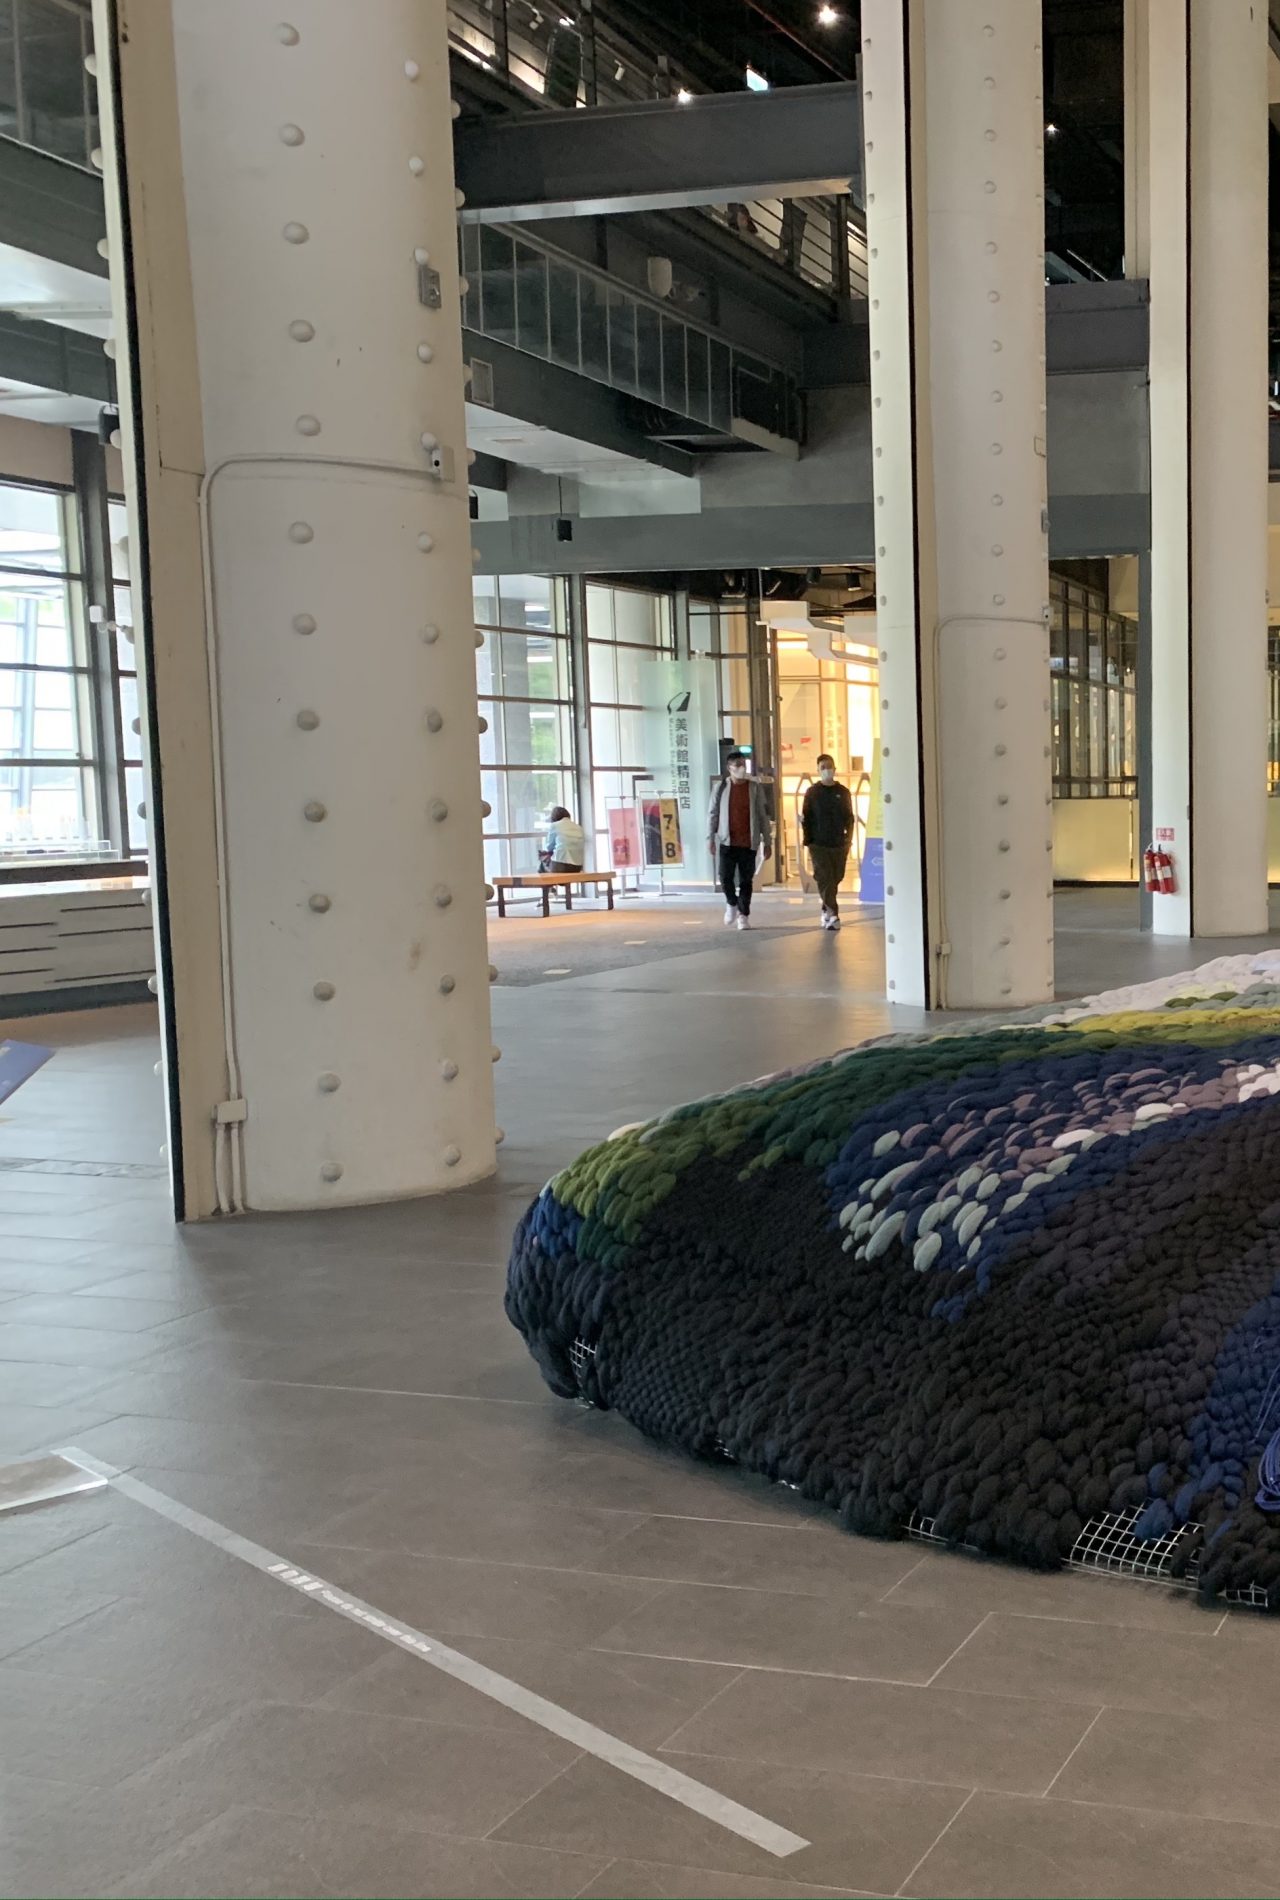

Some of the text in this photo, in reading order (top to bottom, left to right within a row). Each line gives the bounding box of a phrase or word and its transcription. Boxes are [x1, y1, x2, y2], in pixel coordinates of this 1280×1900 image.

[675, 717, 691, 810] 美術館精品店
[663, 814, 673, 830] 7
[665, 842, 676, 858] 8
